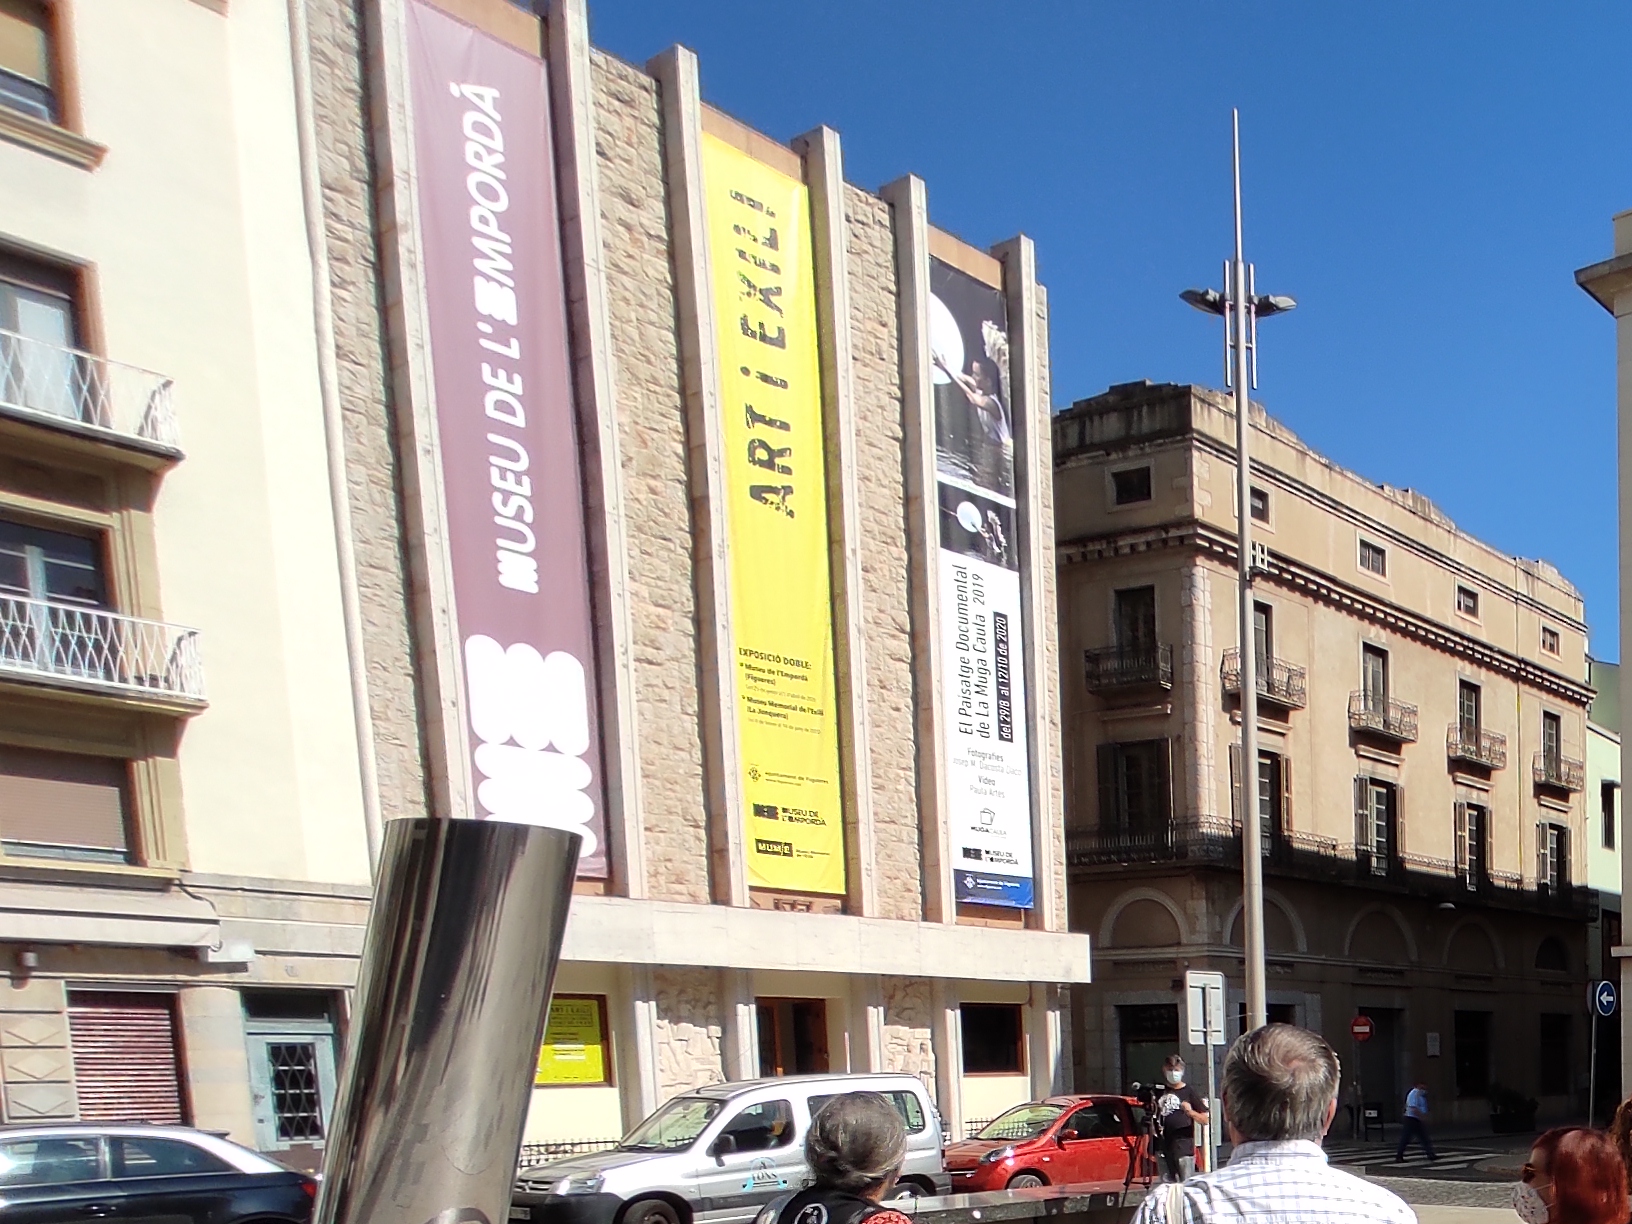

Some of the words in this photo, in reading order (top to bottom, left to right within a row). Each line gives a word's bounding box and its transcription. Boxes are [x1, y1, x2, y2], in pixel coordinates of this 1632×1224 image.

[450, 81, 521, 359] L'EMPORDÀ
[740, 366, 789, 389] i
[481, 362, 526, 428] DE
[745, 403, 795, 519] ART
[486, 433, 539, 594] MUSEU
[972, 573, 985, 606] 2019
[952, 565, 970, 652] Documental
[972, 614, 987, 653] Caula
[996, 617, 1007, 641] 2020
[739, 647, 781, 664] EXPOSICIÓ
[997, 642, 1008, 655] de
[974, 658, 992, 697] Muga
[998, 656, 1009, 683] 12/10
[998, 685, 1010, 697] al
[975, 700, 990, 720] La
[1000, 700, 1011, 721] 29/8
[958, 722, 973, 735] El
[975, 722, 991, 739] de
[1000, 722, 1012, 739] del
[967, 747, 1004, 762] Fotografies
